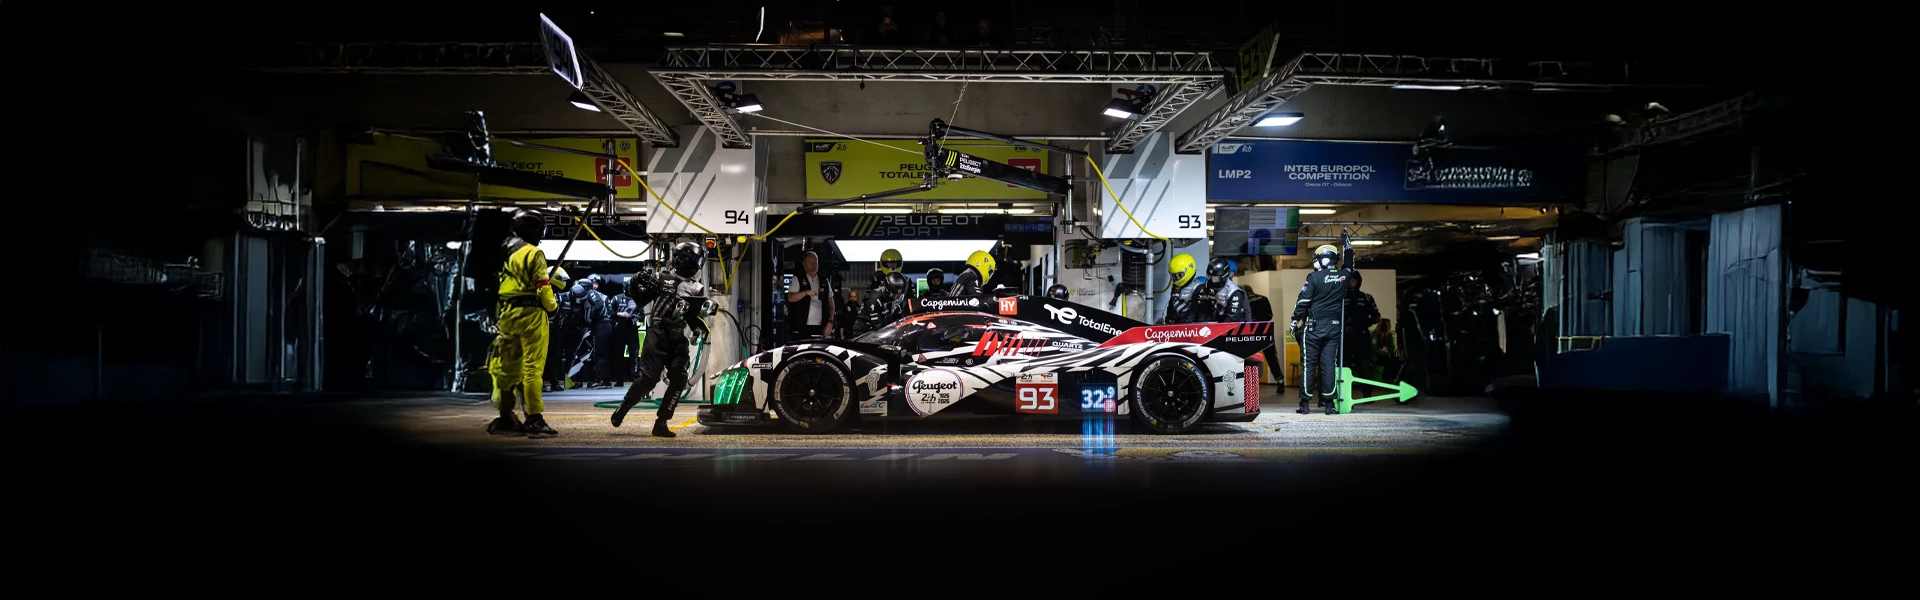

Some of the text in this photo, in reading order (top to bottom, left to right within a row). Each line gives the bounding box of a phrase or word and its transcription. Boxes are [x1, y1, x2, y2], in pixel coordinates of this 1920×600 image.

[553, 33, 570, 78] 94
[1242, 41, 1259, 81] 93
[1218, 169, 1252, 179] LMP2
[1283, 164, 1376, 173] INTER EUROPOL
[1288, 172, 1370, 181] COMPETITION
[724, 210, 749, 225] 94
[879, 215, 984, 226] PEUGEOT
[1178, 215, 1201, 229] 93
[873, 226, 946, 237] SPORT
[920, 298, 969, 310] Capgemini
[1000, 301, 1015, 312] HY
[1144, 327, 1199, 342] Capgemini
[912, 380, 958, 394] Peugeot
[1019, 387, 1055, 410] 93
